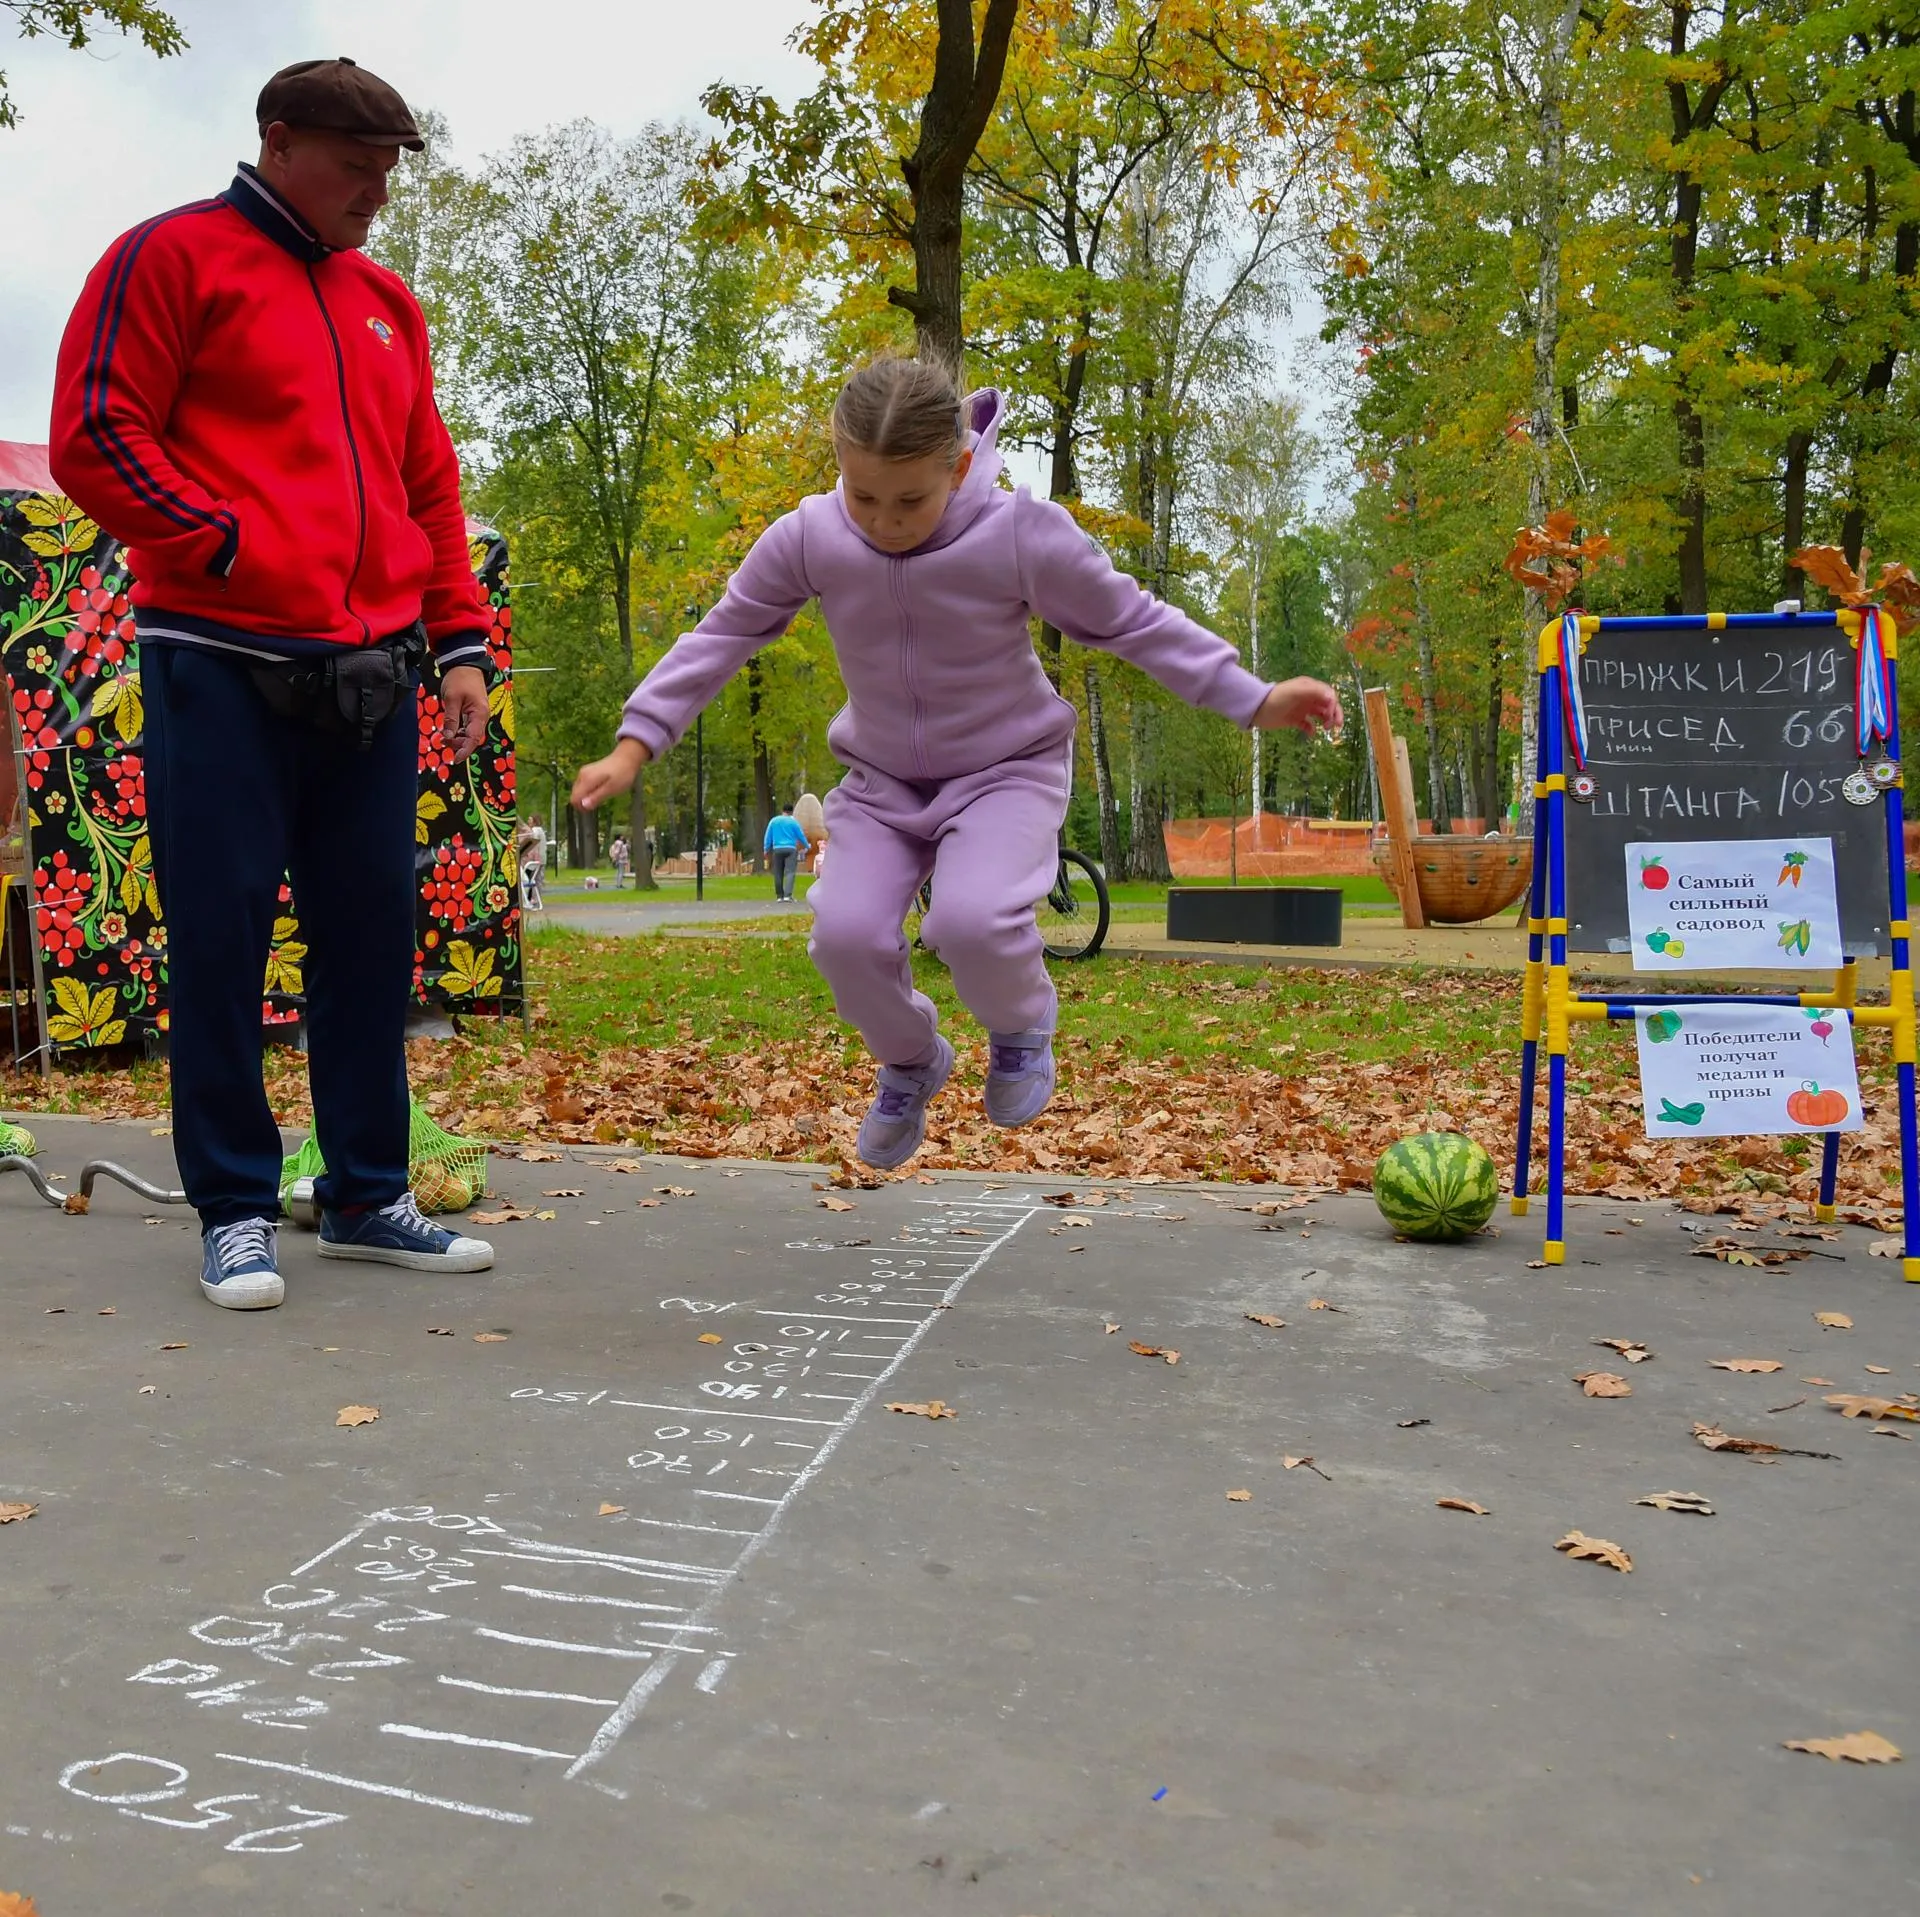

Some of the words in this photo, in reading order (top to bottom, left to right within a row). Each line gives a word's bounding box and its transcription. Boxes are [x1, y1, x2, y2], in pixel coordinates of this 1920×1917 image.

[1583, 658, 1745, 693] ПРЫЖКИ
[1756, 648, 1847, 693] 219
[1782, 704, 1853, 748] 66
[1591, 782, 1760, 819] ШТАНГА
[1777, 769, 1843, 817] 105
[1677, 873, 1755, 890] Самый
[1668, 895, 1769, 912] сильный
[1675, 916, 1766, 932] садовод
[1683, 1031, 1802, 1047] Победители
[1699, 1050, 1778, 1066] получат
[1696, 1069, 1767, 1083] медали
[1773, 1068, 1785, 1080] и
[1708, 1086, 1772, 1102] призы
[870, 1258, 927, 1268] 60
[871, 1270, 923, 1280] 70
[838, 1282, 887, 1293] 80
[814, 1293, 871, 1306] 90
[778, 1325, 851, 1342] 110
[733, 1342, 818, 1359] 120
[723, 1359, 811, 1377] 130
[510, 1387, 608, 1405] 150
[654, 1425, 755, 1448] 160
[626, 1450, 730, 1475] 170
[58, 1750, 351, 1853] 250
